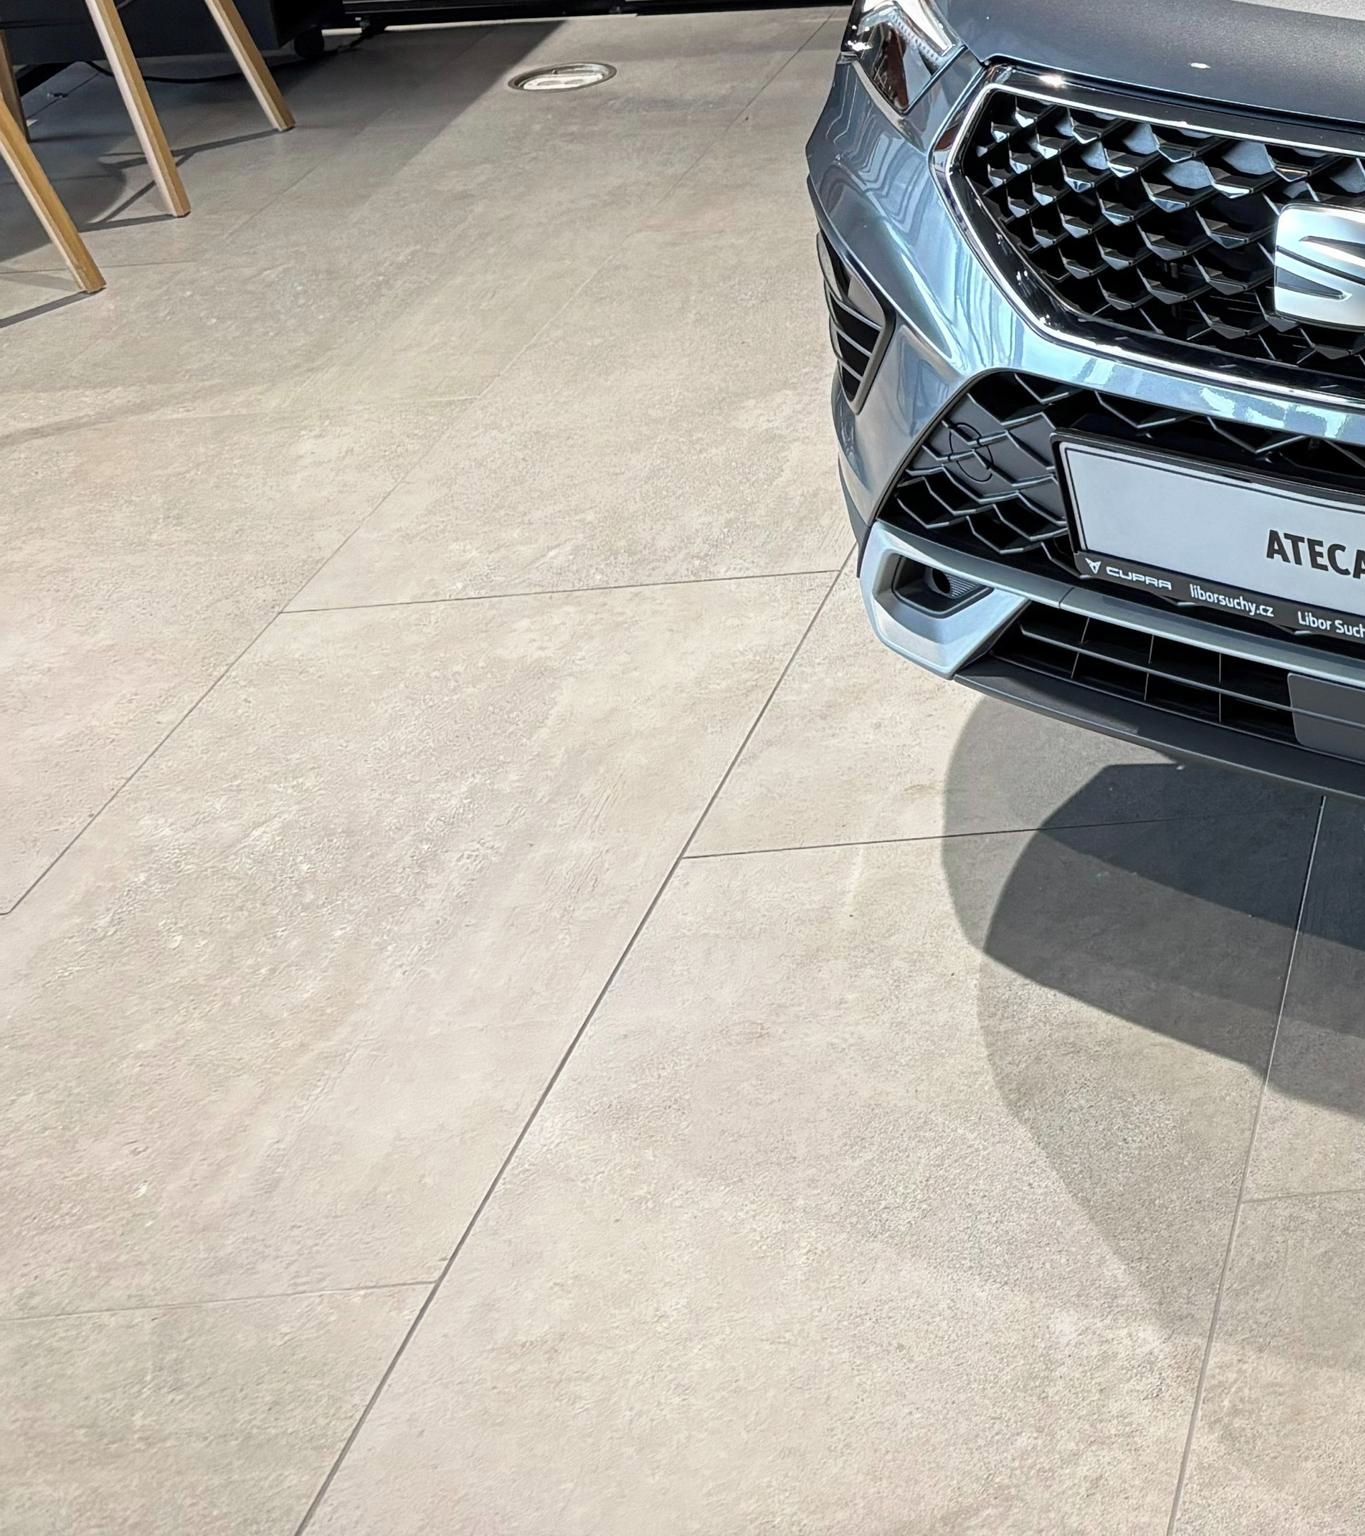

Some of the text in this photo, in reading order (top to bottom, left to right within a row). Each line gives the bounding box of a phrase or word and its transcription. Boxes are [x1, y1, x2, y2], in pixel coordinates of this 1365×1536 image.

[1106, 566, 1172, 591] CUPRA
[1189, 584, 1274, 617] liborsuchy.cz
[1297, 611, 1332, 631] Libor
